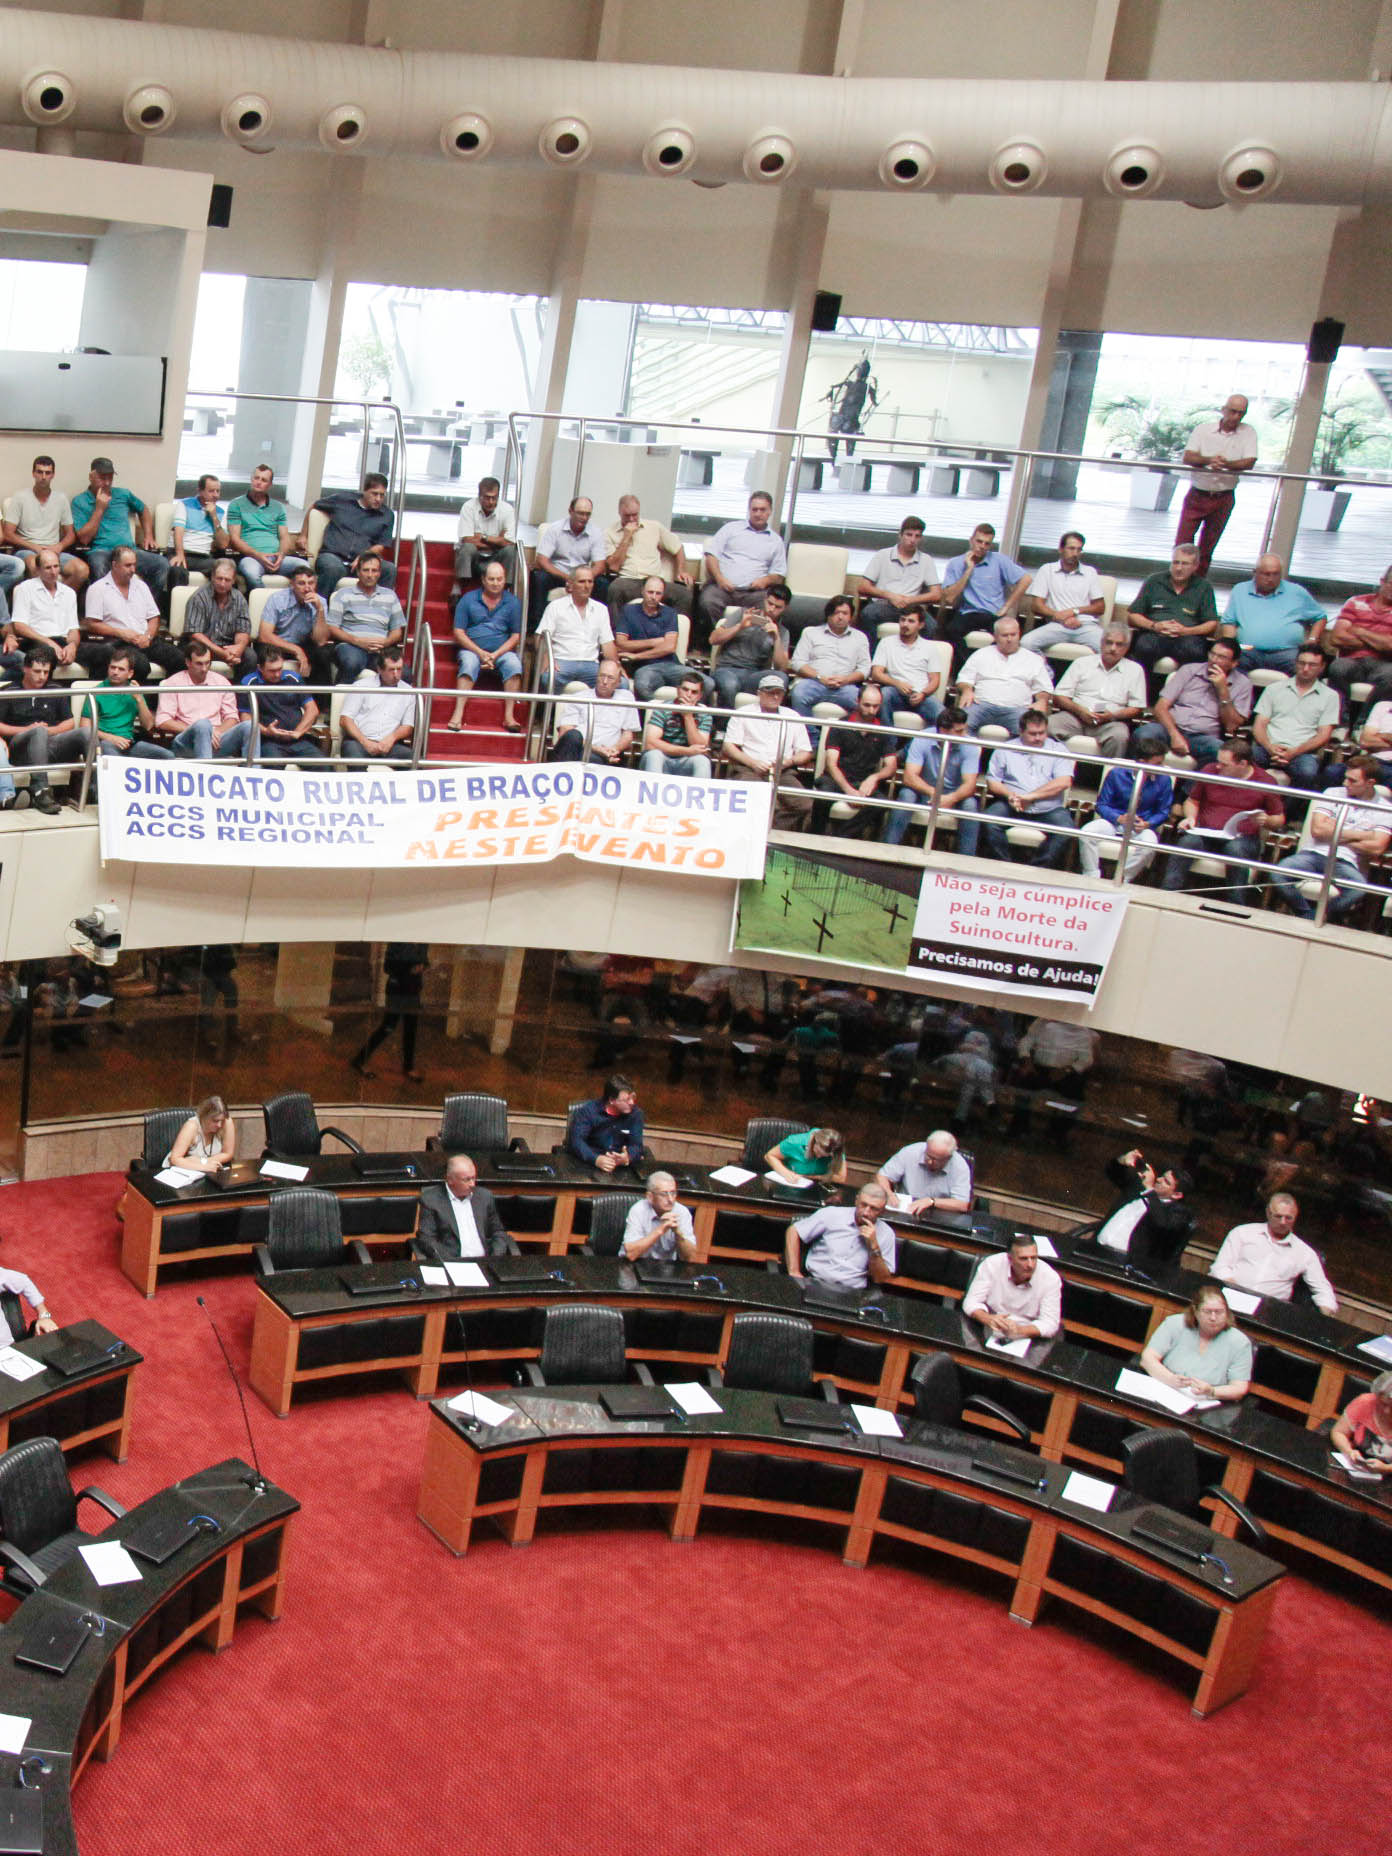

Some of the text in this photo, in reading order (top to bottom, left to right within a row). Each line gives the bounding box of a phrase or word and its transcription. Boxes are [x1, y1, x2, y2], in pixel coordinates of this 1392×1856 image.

[124, 766, 748, 814] SINDICATO RURAL DE BRAÇO DO NORTE
[125, 802, 384, 827] ACCS MUNICIPAL
[126, 821, 375, 845] ACCS REGIONAL
[433, 800, 701, 838] PRESENTES
[404, 826, 726, 869] NESTE EVENTO
[934, 874, 1113, 913] Não seja cúmplice
[949, 901, 1088, 931] pela Morte da
[949, 920, 1078, 952] Suinocultura.
[917, 947, 1099, 986] Precisamos de Ajuda!
